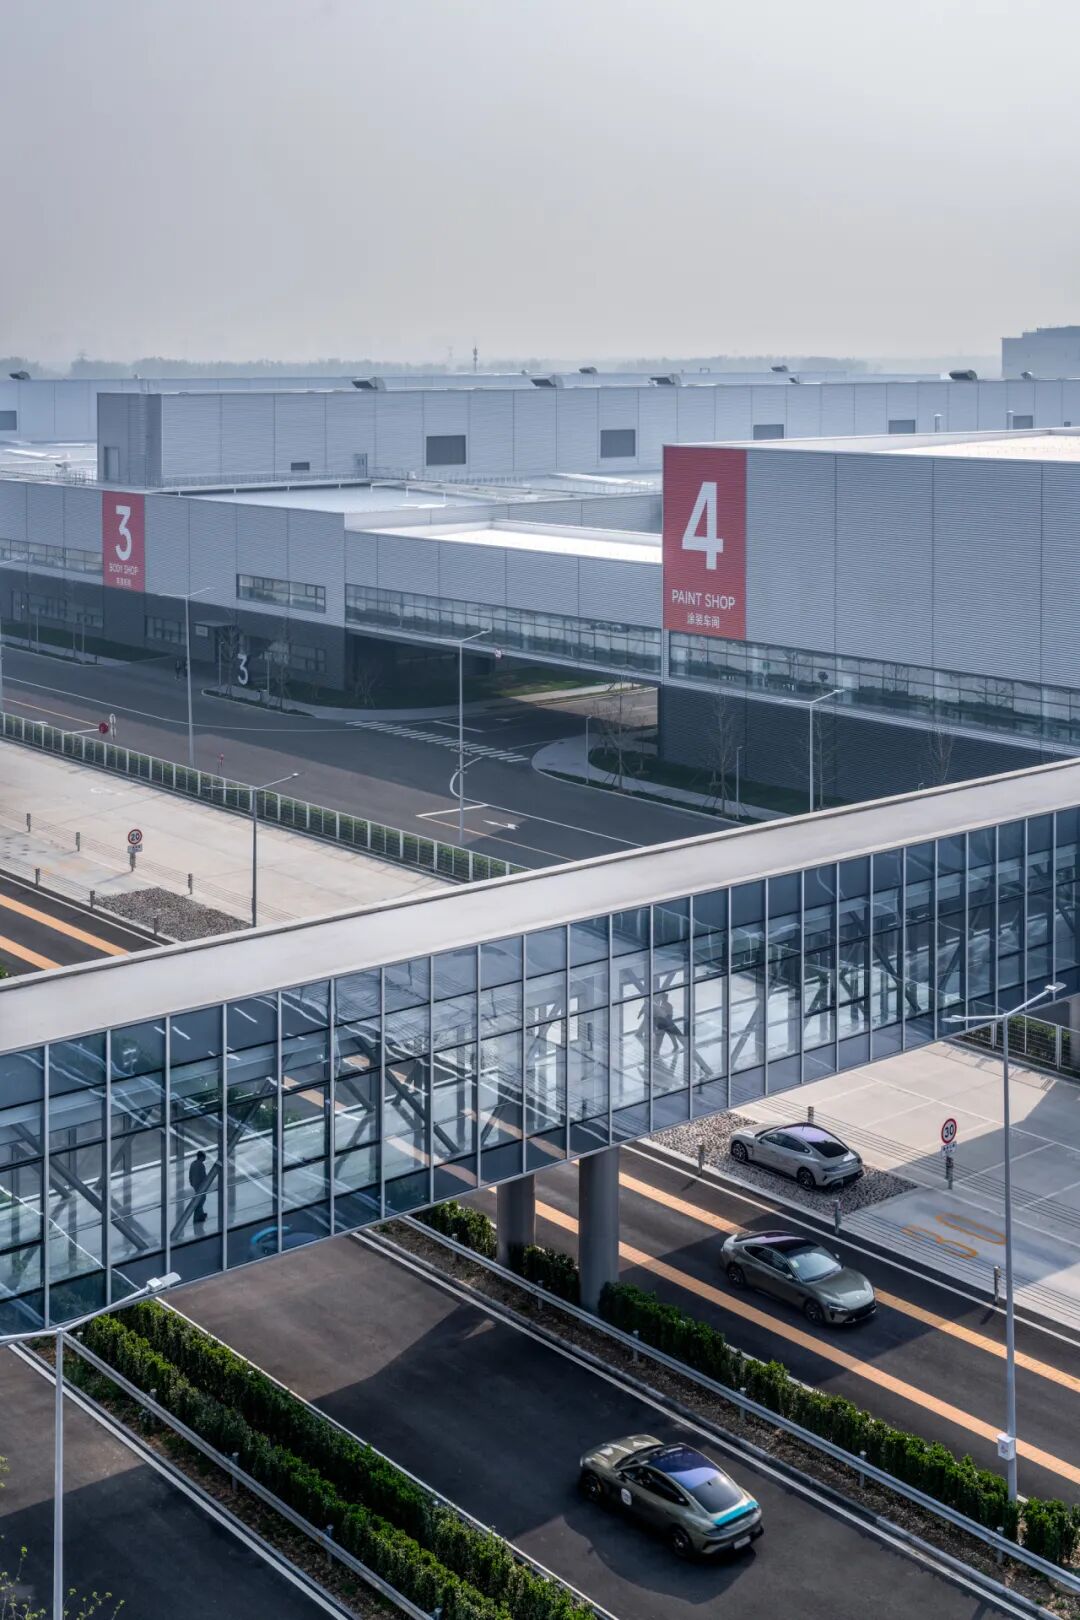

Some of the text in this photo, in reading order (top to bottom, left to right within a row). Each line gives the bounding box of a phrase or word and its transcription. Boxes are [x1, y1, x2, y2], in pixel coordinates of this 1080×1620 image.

[115, 505, 132, 560] 3
[682, 481, 723, 570] 4
[123, 564, 138, 575] SHOP
[671, 589, 736, 610] PAINT SHOP
[237, 653, 249, 685] 3
[131, 832, 140, 842] 20
[944, 1123, 954, 1139] 30
